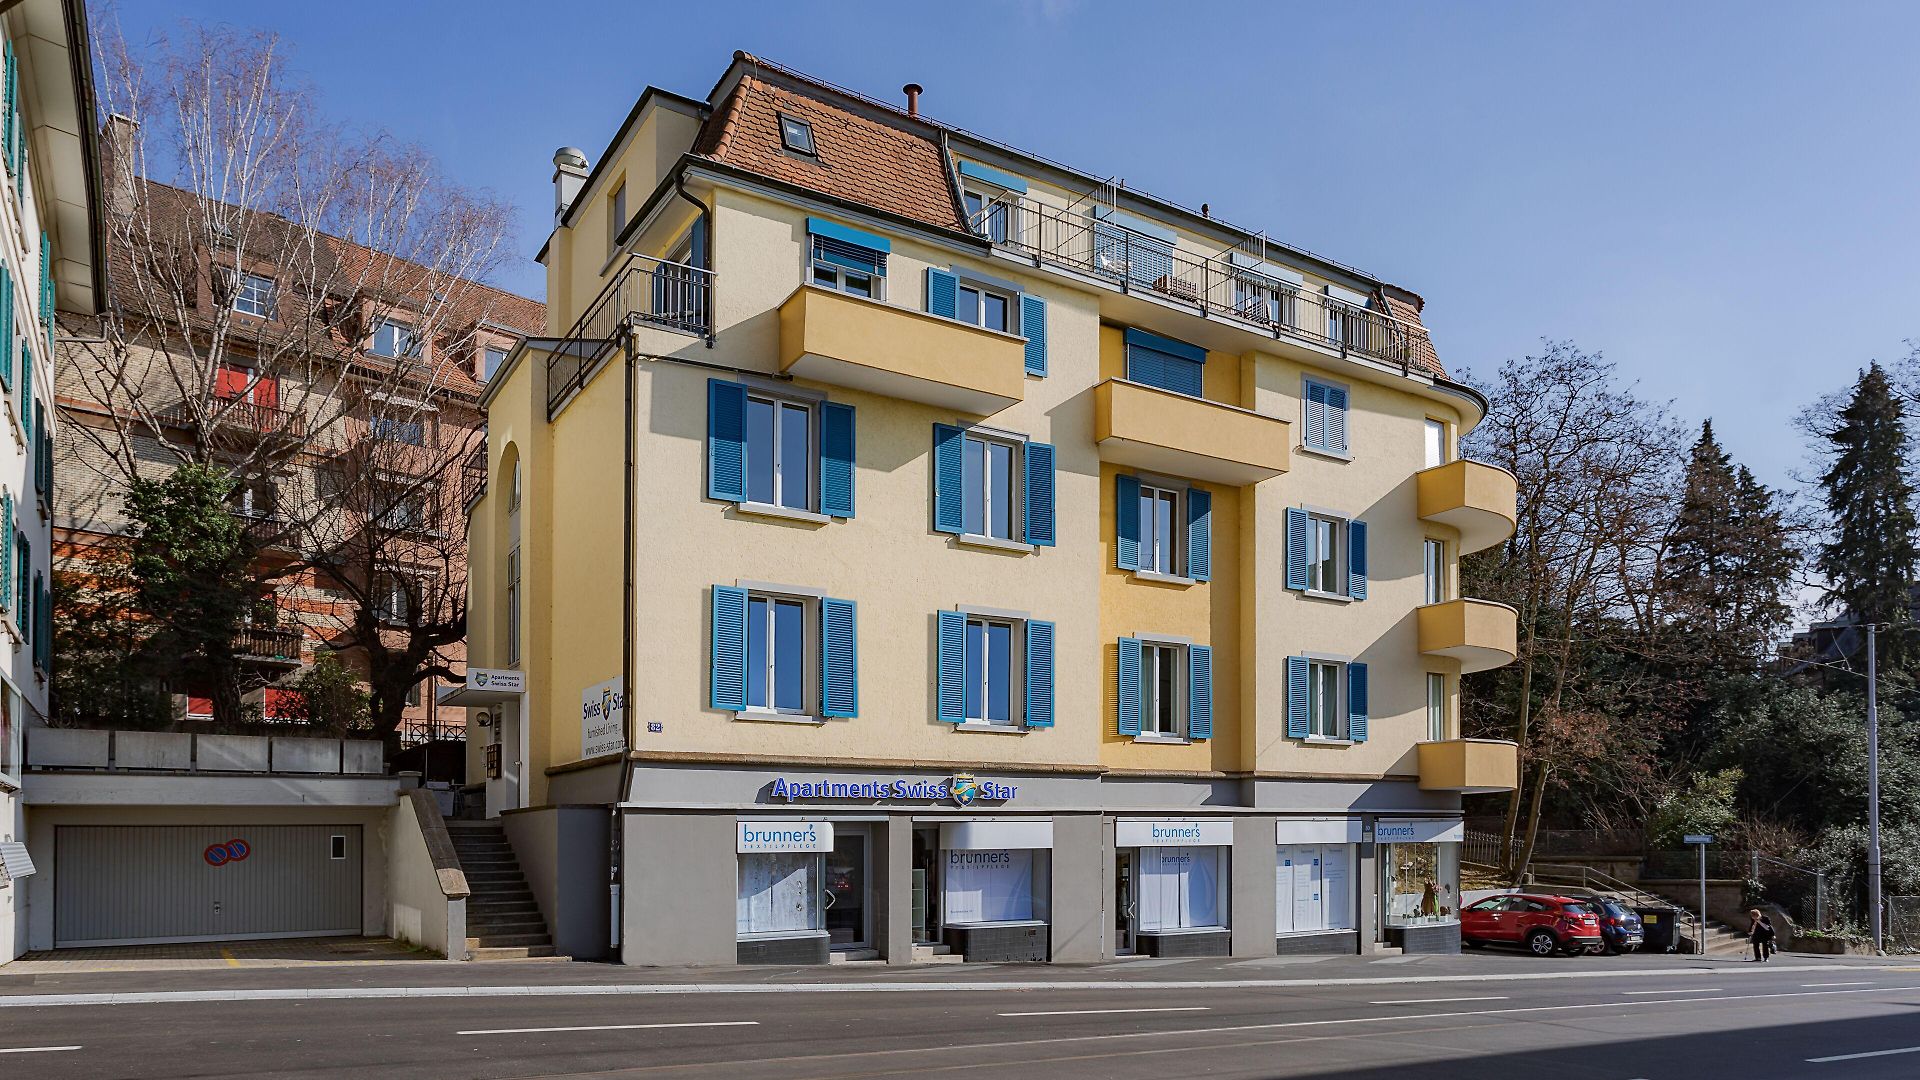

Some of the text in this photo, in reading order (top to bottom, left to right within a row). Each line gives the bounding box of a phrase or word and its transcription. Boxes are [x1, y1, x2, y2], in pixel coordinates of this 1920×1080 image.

[583, 692, 624, 720] Swiss Sta
[650, 723, 661, 732] 82
[771, 776, 1019, 802] Apartments Swiss Star
[744, 823, 817, 843] brunner's
[1152, 822, 1201, 838] brunner's
[1377, 822, 1415, 836] brunner's
[950, 849, 1010, 864] brunners
